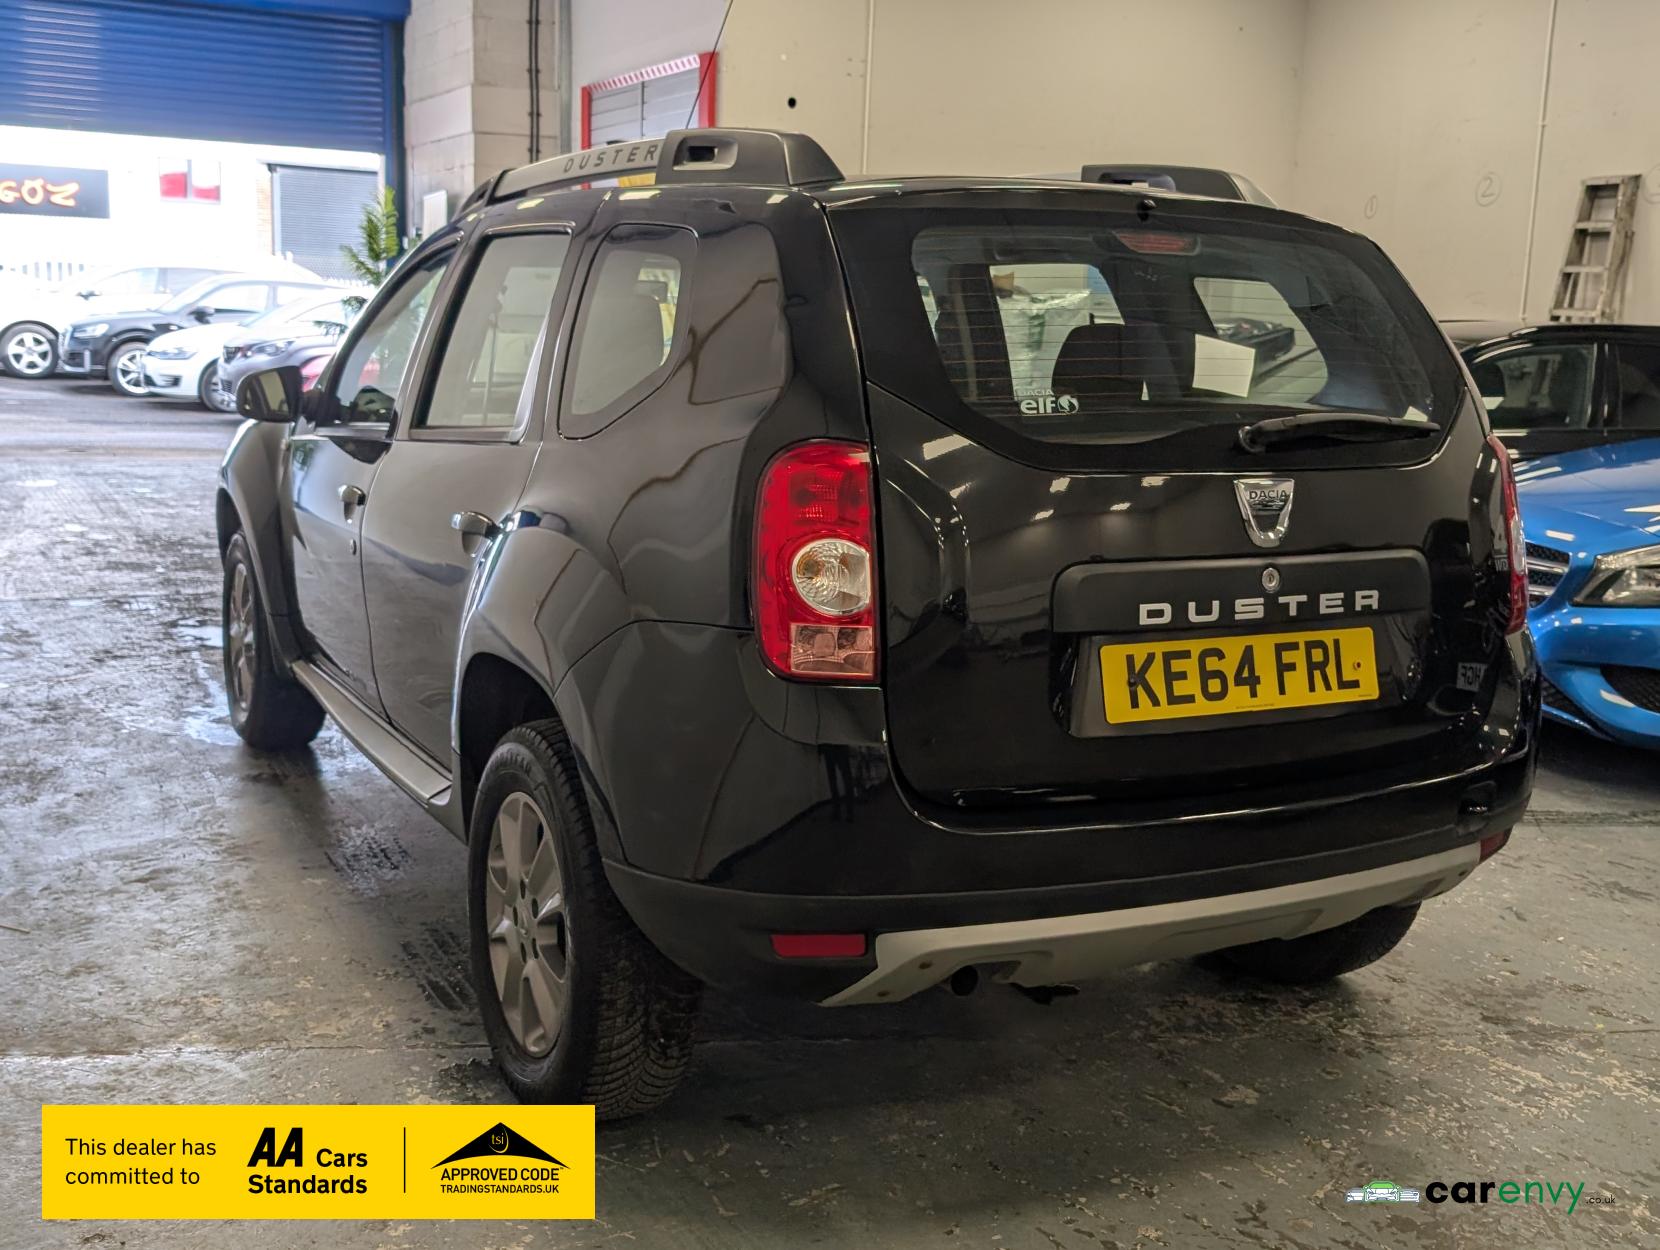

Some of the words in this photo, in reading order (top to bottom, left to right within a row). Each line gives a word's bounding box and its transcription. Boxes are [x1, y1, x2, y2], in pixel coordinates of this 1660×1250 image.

[563, 144, 658, 173] DUSTER
[1020, 396, 1056, 414] elf
[1250, 490, 1287, 500] DACIA
[1139, 590, 1380, 626] DUSTER
[1125, 644, 1261, 710] KE64
[1274, 638, 1361, 696] FRL
